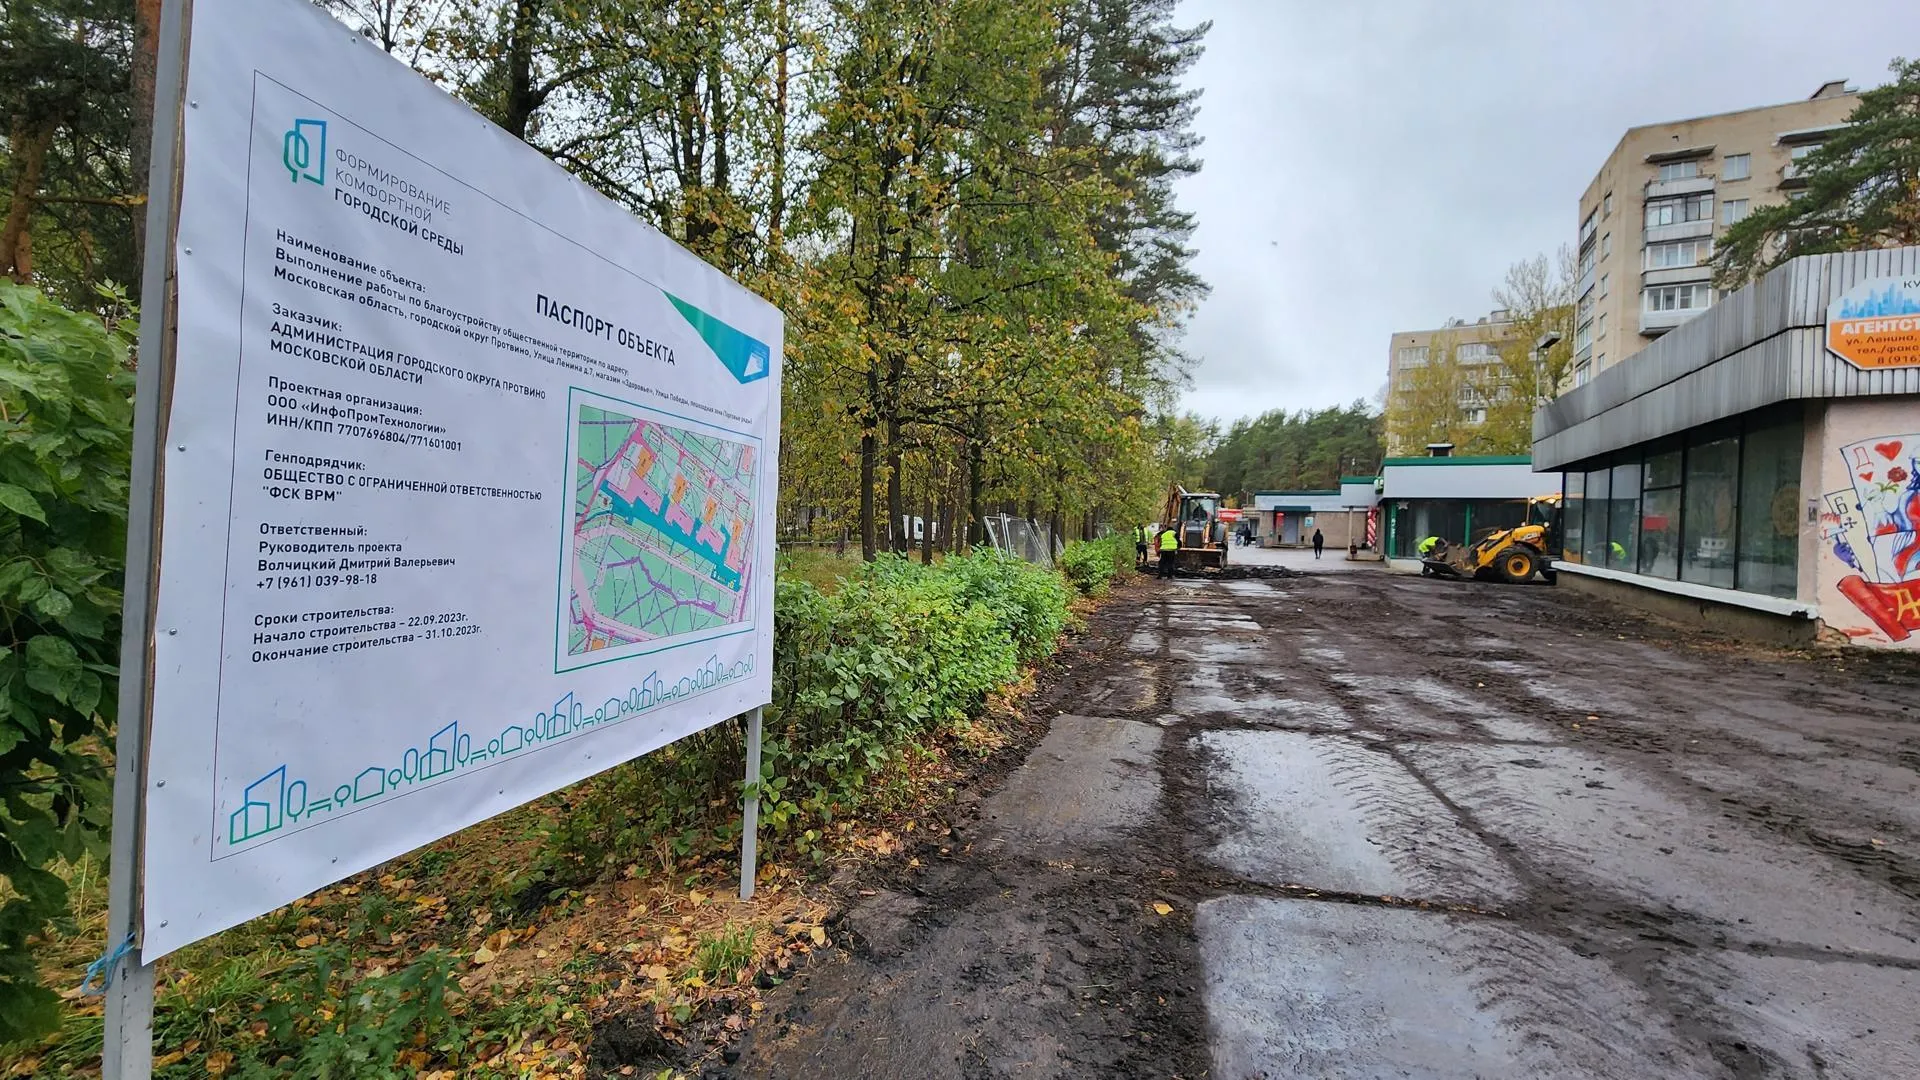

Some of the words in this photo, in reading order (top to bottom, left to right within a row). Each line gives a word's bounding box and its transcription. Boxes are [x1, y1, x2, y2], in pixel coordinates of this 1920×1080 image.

[335, 167, 432, 223] КОМФОРТНОЙ
[336, 149, 451, 215] ФОРМИРОВАНИЕ
[334, 188, 418, 236] ГОРОДСКОЙ
[421, 228, 464, 256] СРЕДЫ
[276, 229, 377, 274] Наименование
[379, 268, 426, 293] объекта:
[272, 303, 342, 332] Заказчик:
[274, 266, 355, 301] Московская
[358, 295, 408, 320] область,
[409, 310, 461, 335] городской
[463, 329, 490, 344] округ
[491, 335, 532, 358] Протвино,
[533, 350, 555, 365] Улица
[556, 357, 583, 372] Ленина
[595, 371, 621, 384] магазин
[275, 247, 363, 286] Выполнение
[366, 280, 406, 302] работы
[408, 296, 422, 307] по
[424, 299, 502, 335] благоустройству
[502, 328, 558, 352] общественной
[559, 346, 598, 365] территории
[536, 293, 614, 341] ПАСПОРТ
[617, 328, 676, 366] ОБЪЕКТА
[270, 321, 394, 362] АДМИНИСТРАЦИЯ
[396, 353, 464, 380] ГОРОДСКОГО
[466, 371, 501, 389] ОКРУГА
[502, 381, 546, 400] ПРОТВИНО
[270, 339, 367, 372] МОСКОВСКОЙ
[369, 363, 424, 385] ОБЛАСТИ
[267, 394, 297, 410] ООО
[301, 401, 447, 434] «ИнфоПромТехнологии»
[268, 375, 342, 401] Проектная
[345, 393, 423, 416] организация:
[267, 412, 334, 434] ИНН/КПП
[337, 423, 462, 452] 7707696804/771601001
[264, 449, 366, 470] Генподрядчик:
[262, 486, 301, 500] "ФСК
[304, 488, 342, 502] ВРМ"
[263, 467, 344, 486] ОБЩЕСТВО
[347, 475, 356, 487] С
[358, 476, 448, 494] ОГРАНИЧЕННОЙ
[449, 484, 542, 501] ОТВЕТСТВЕННОСТЬЮ
[1834, 496, 1849, 515] 6
[259, 523, 368, 537] Ответственный:
[259, 541, 355, 556] Руководитель
[357, 543, 402, 555] проекта
[256, 577, 274, 589] +7
[277, 575, 312, 589] (961)
[315, 573, 377, 587] 039-98-18
[258, 558, 336, 571] Волчицкий
[339, 557, 391, 571] Дмитрий
[393, 557, 456, 569] Валерьевич
[253, 630, 306, 645] Начало
[309, 620, 396, 639] строительства
[407, 612, 469, 627] 22.09.2023г.
[254, 613, 298, 628] Сроки
[301, 606, 395, 623] строительства:
[251, 644, 329, 662] Окончание
[332, 633, 415, 653] строительства
[425, 624, 482, 640] 31.10.2023г.
